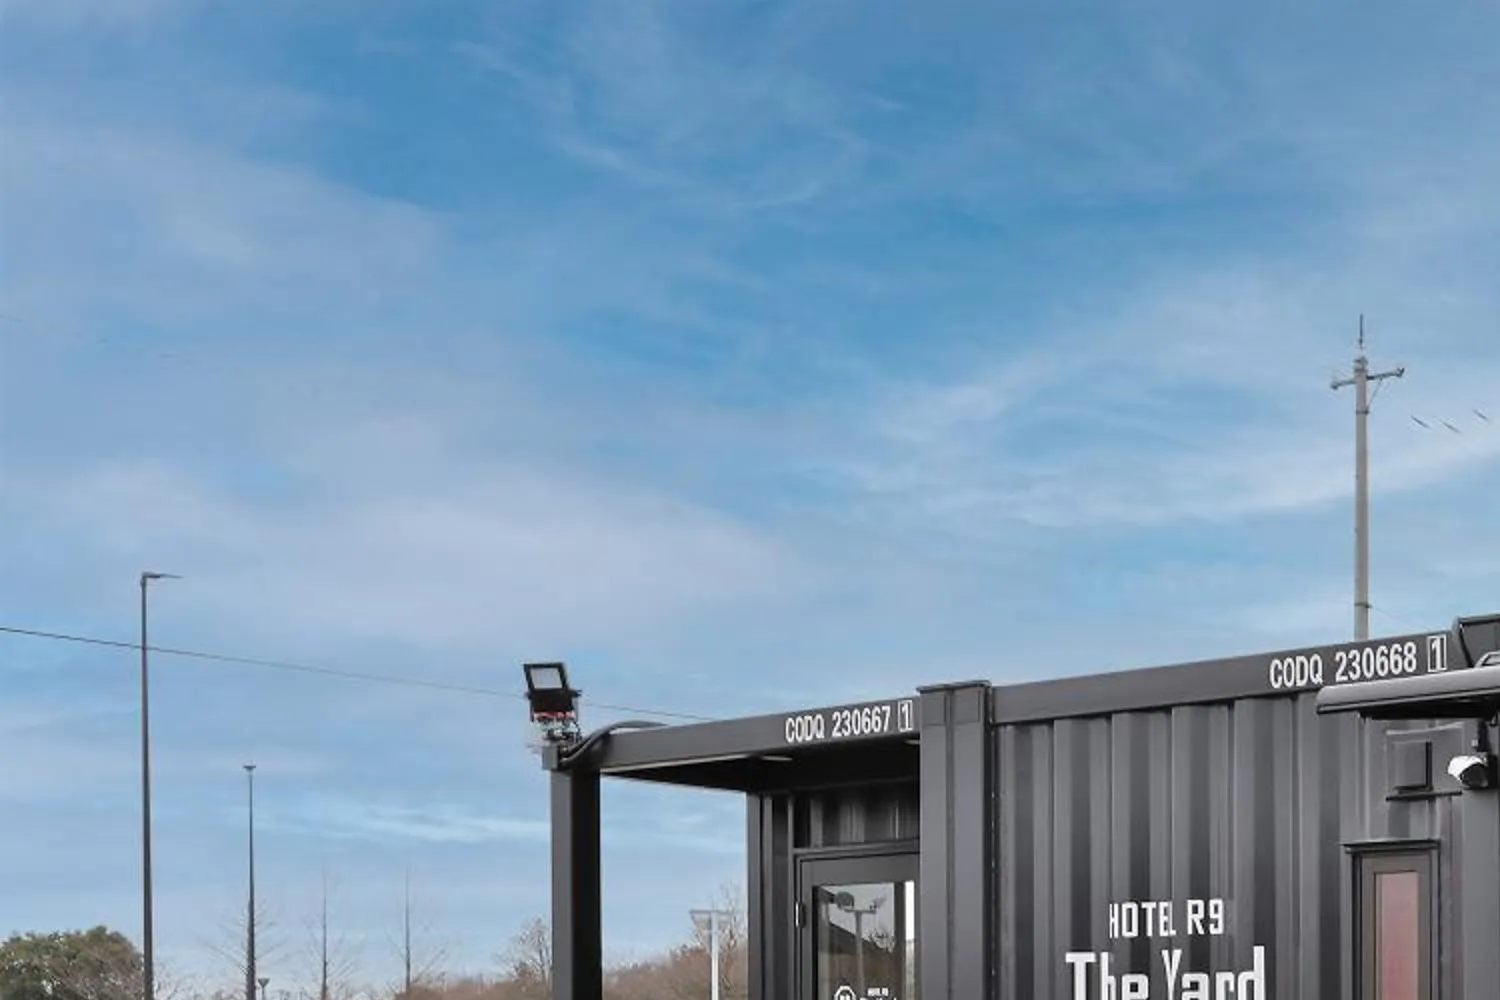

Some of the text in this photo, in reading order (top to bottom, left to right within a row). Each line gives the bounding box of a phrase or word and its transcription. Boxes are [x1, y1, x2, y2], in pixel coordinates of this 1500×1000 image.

[1269, 653, 1324, 689] CODQ
[1335, 641, 1417, 682] 230668
[785, 713, 825, 743] CODQ
[831, 705, 891, 738] 230667
[1109, 899, 1224, 939] HOTEL R9
